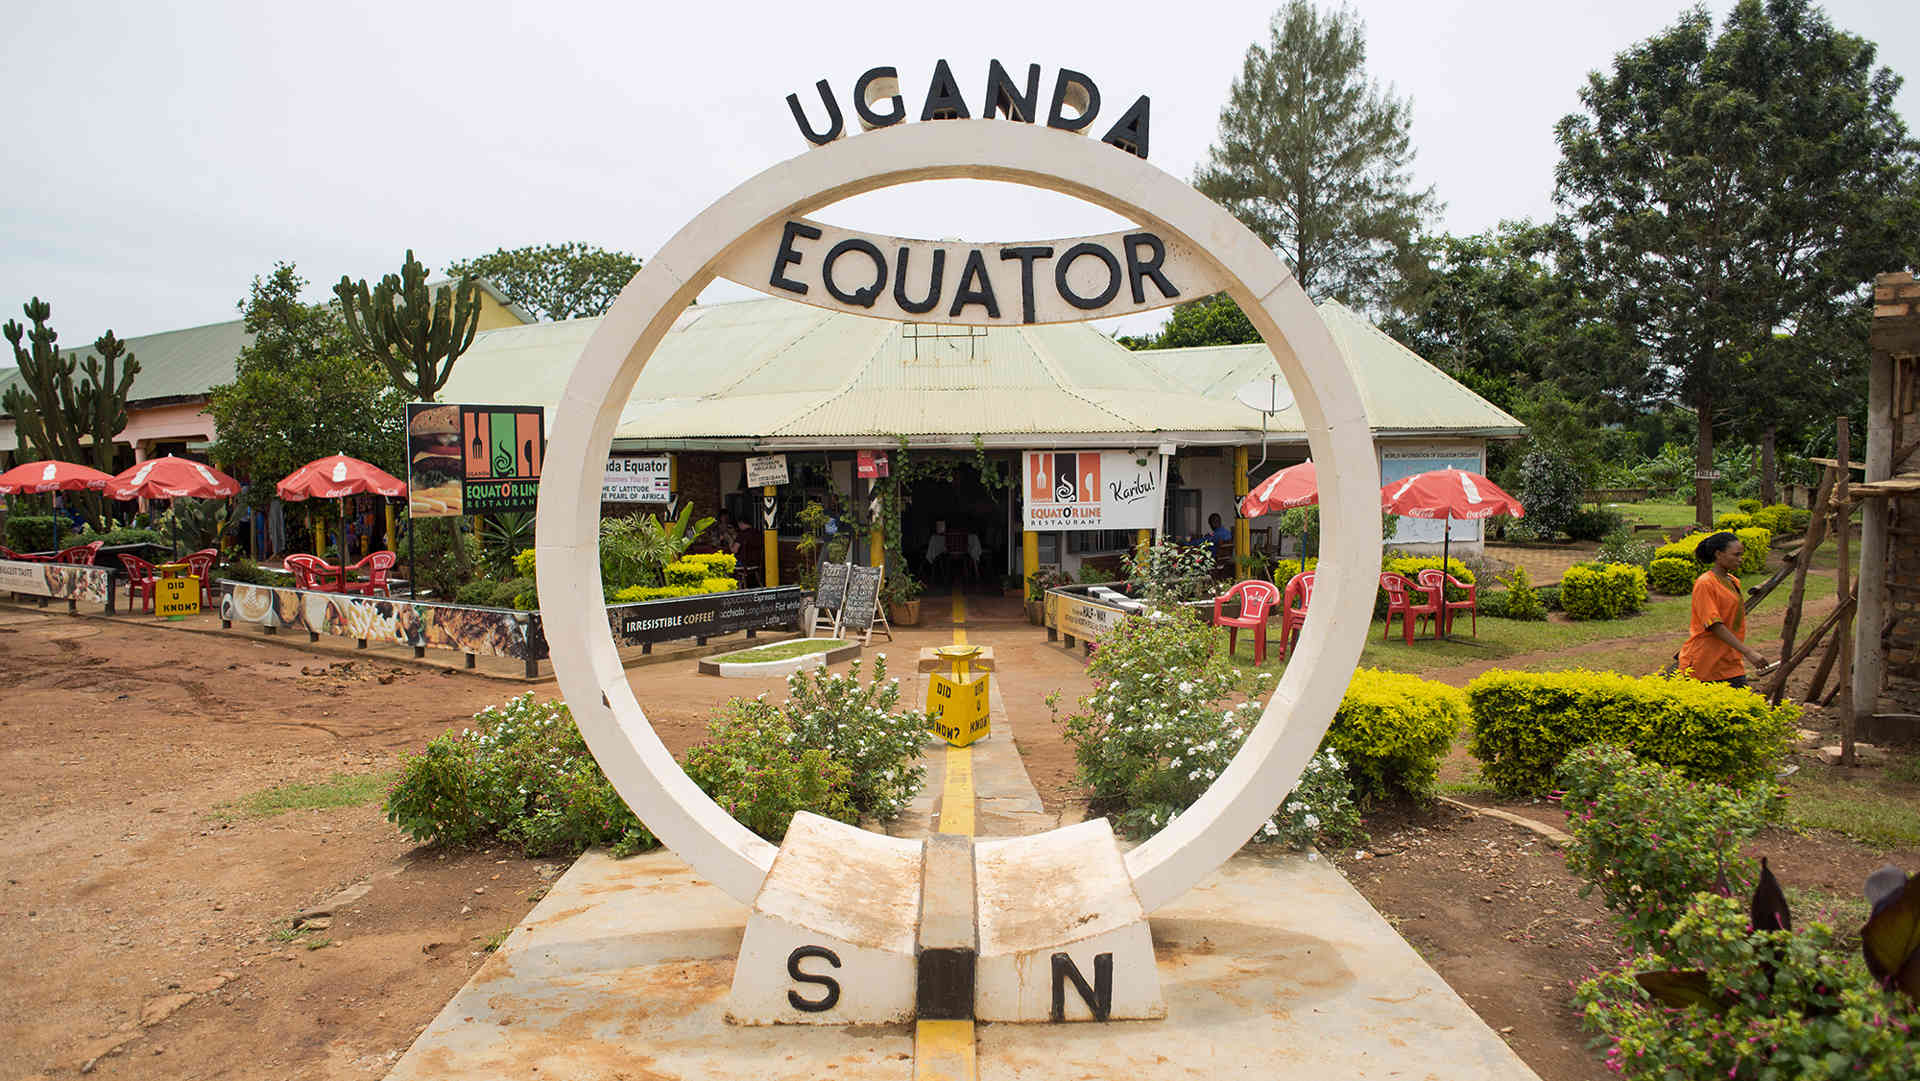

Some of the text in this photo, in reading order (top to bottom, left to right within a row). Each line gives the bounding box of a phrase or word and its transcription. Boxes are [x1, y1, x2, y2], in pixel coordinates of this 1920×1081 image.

[785, 58, 1150, 160] UGANDA
[768, 221, 1181, 324] EQUATOR
[624, 460, 667, 475] Equator
[466, 482, 520, 499] EQUATOR
[1109, 471, 1155, 502] Karibu!
[466, 499, 537, 508] RESTAURAN
[1031, 505, 1101, 519] EQUATOR LINE
[167, 581, 185, 590] DID
[172, 592, 180, 600] U
[163, 601, 197, 612] KNOW?
[626, 615, 682, 632] IRRESISTIBLE
[683, 611, 715, 625] COFFEE!
[937, 682, 952, 698] DID
[930, 721, 960, 740] NOW?
[786, 944, 842, 1013] S
[1050, 951, 1114, 1022] N
